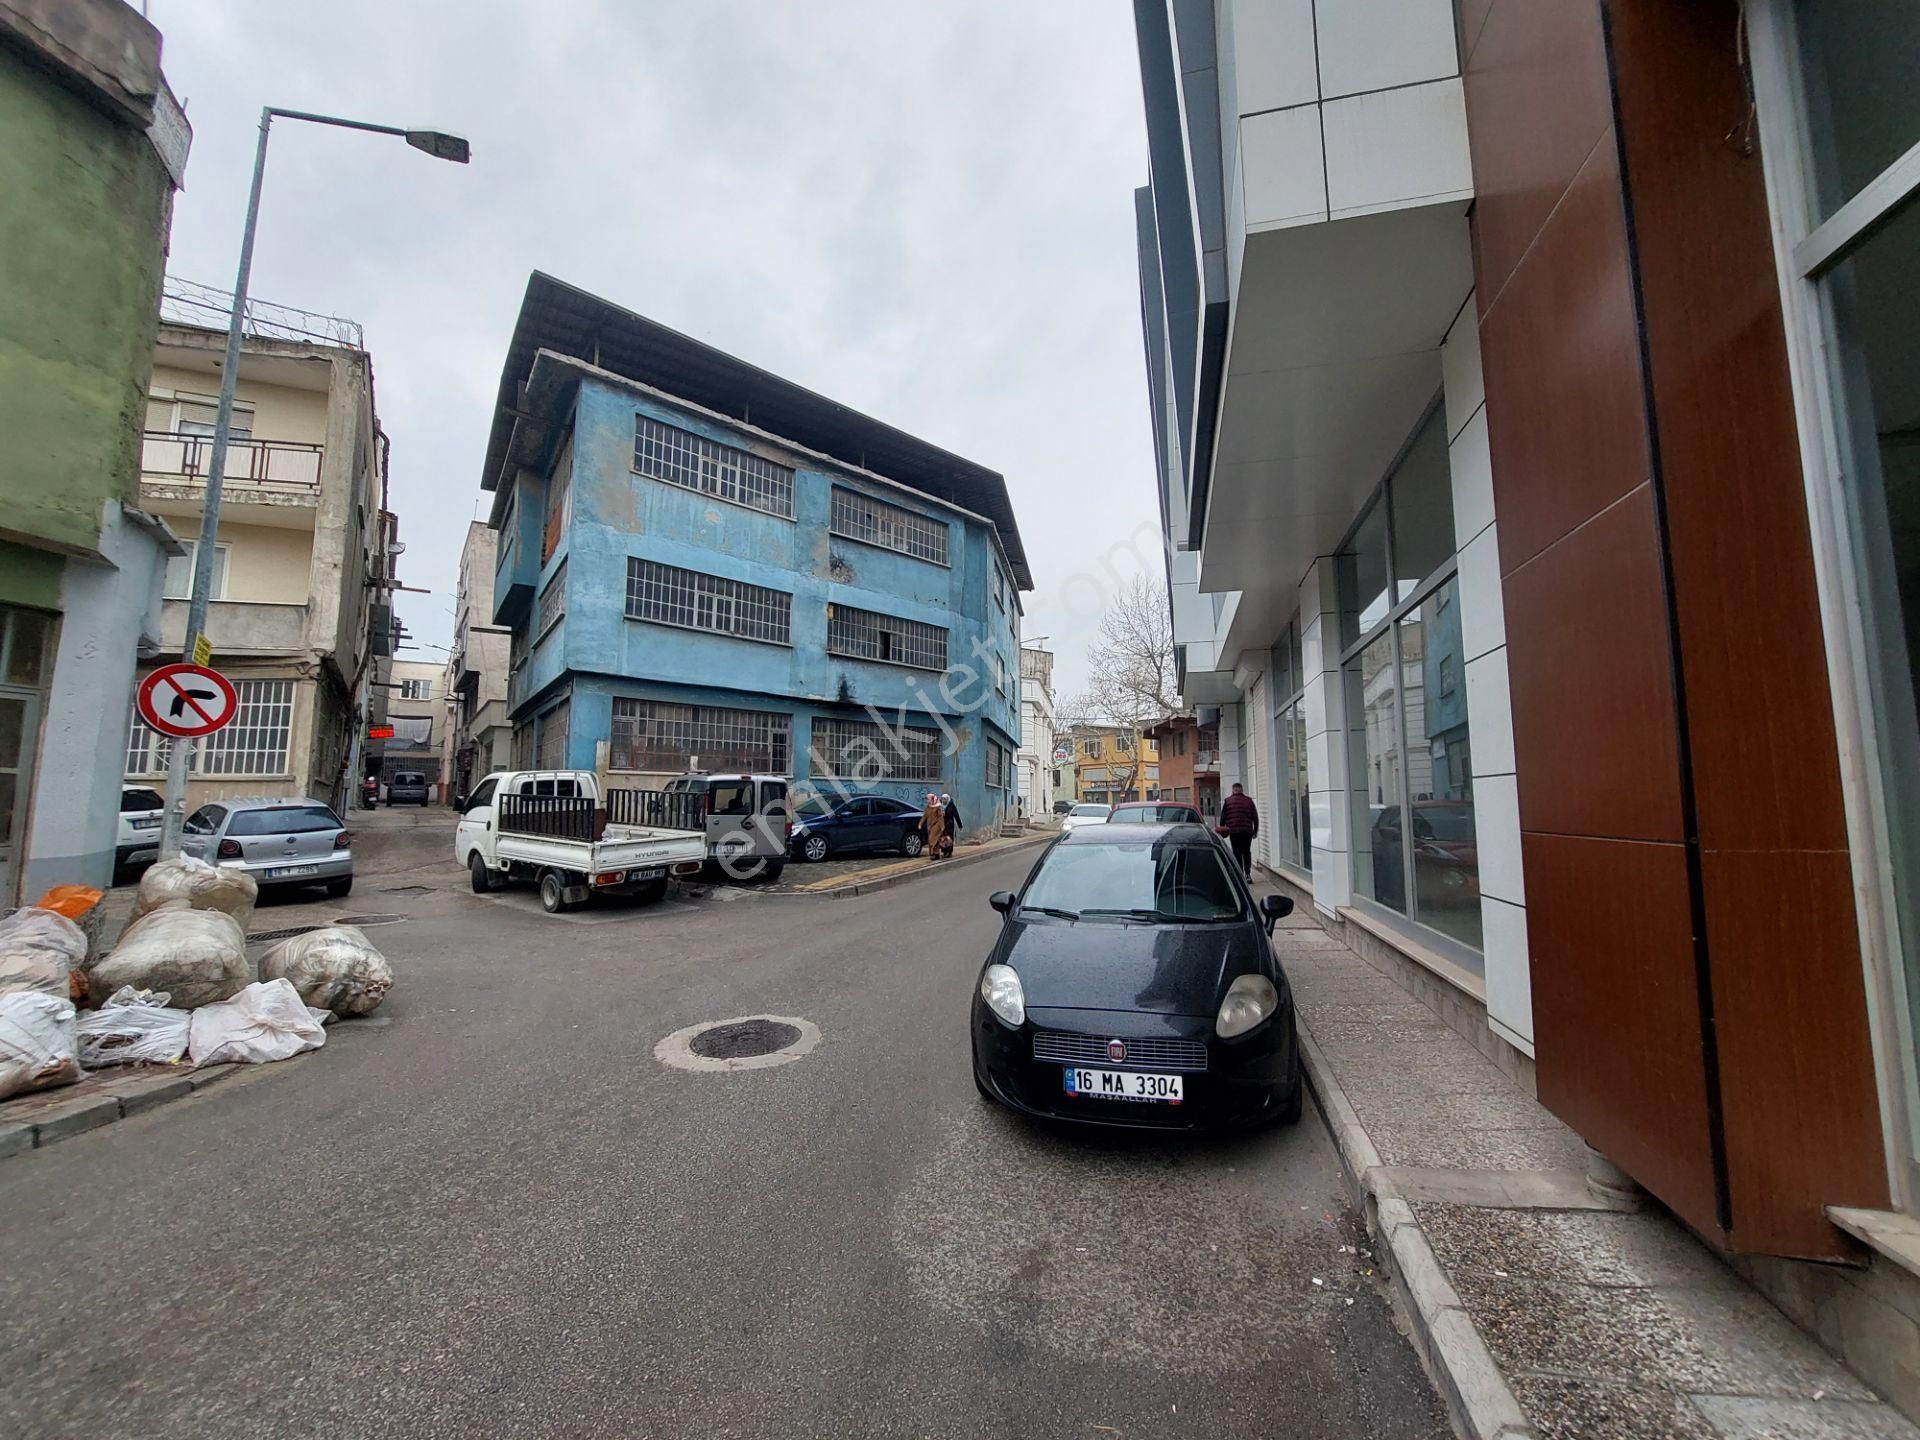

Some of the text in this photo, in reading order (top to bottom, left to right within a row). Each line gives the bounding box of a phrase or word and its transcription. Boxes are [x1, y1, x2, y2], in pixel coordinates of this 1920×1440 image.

[1076, 1071, 1092, 1090] 16
[1102, 1073, 1124, 1093] MA
[1136, 1076, 1179, 1097] 3304
